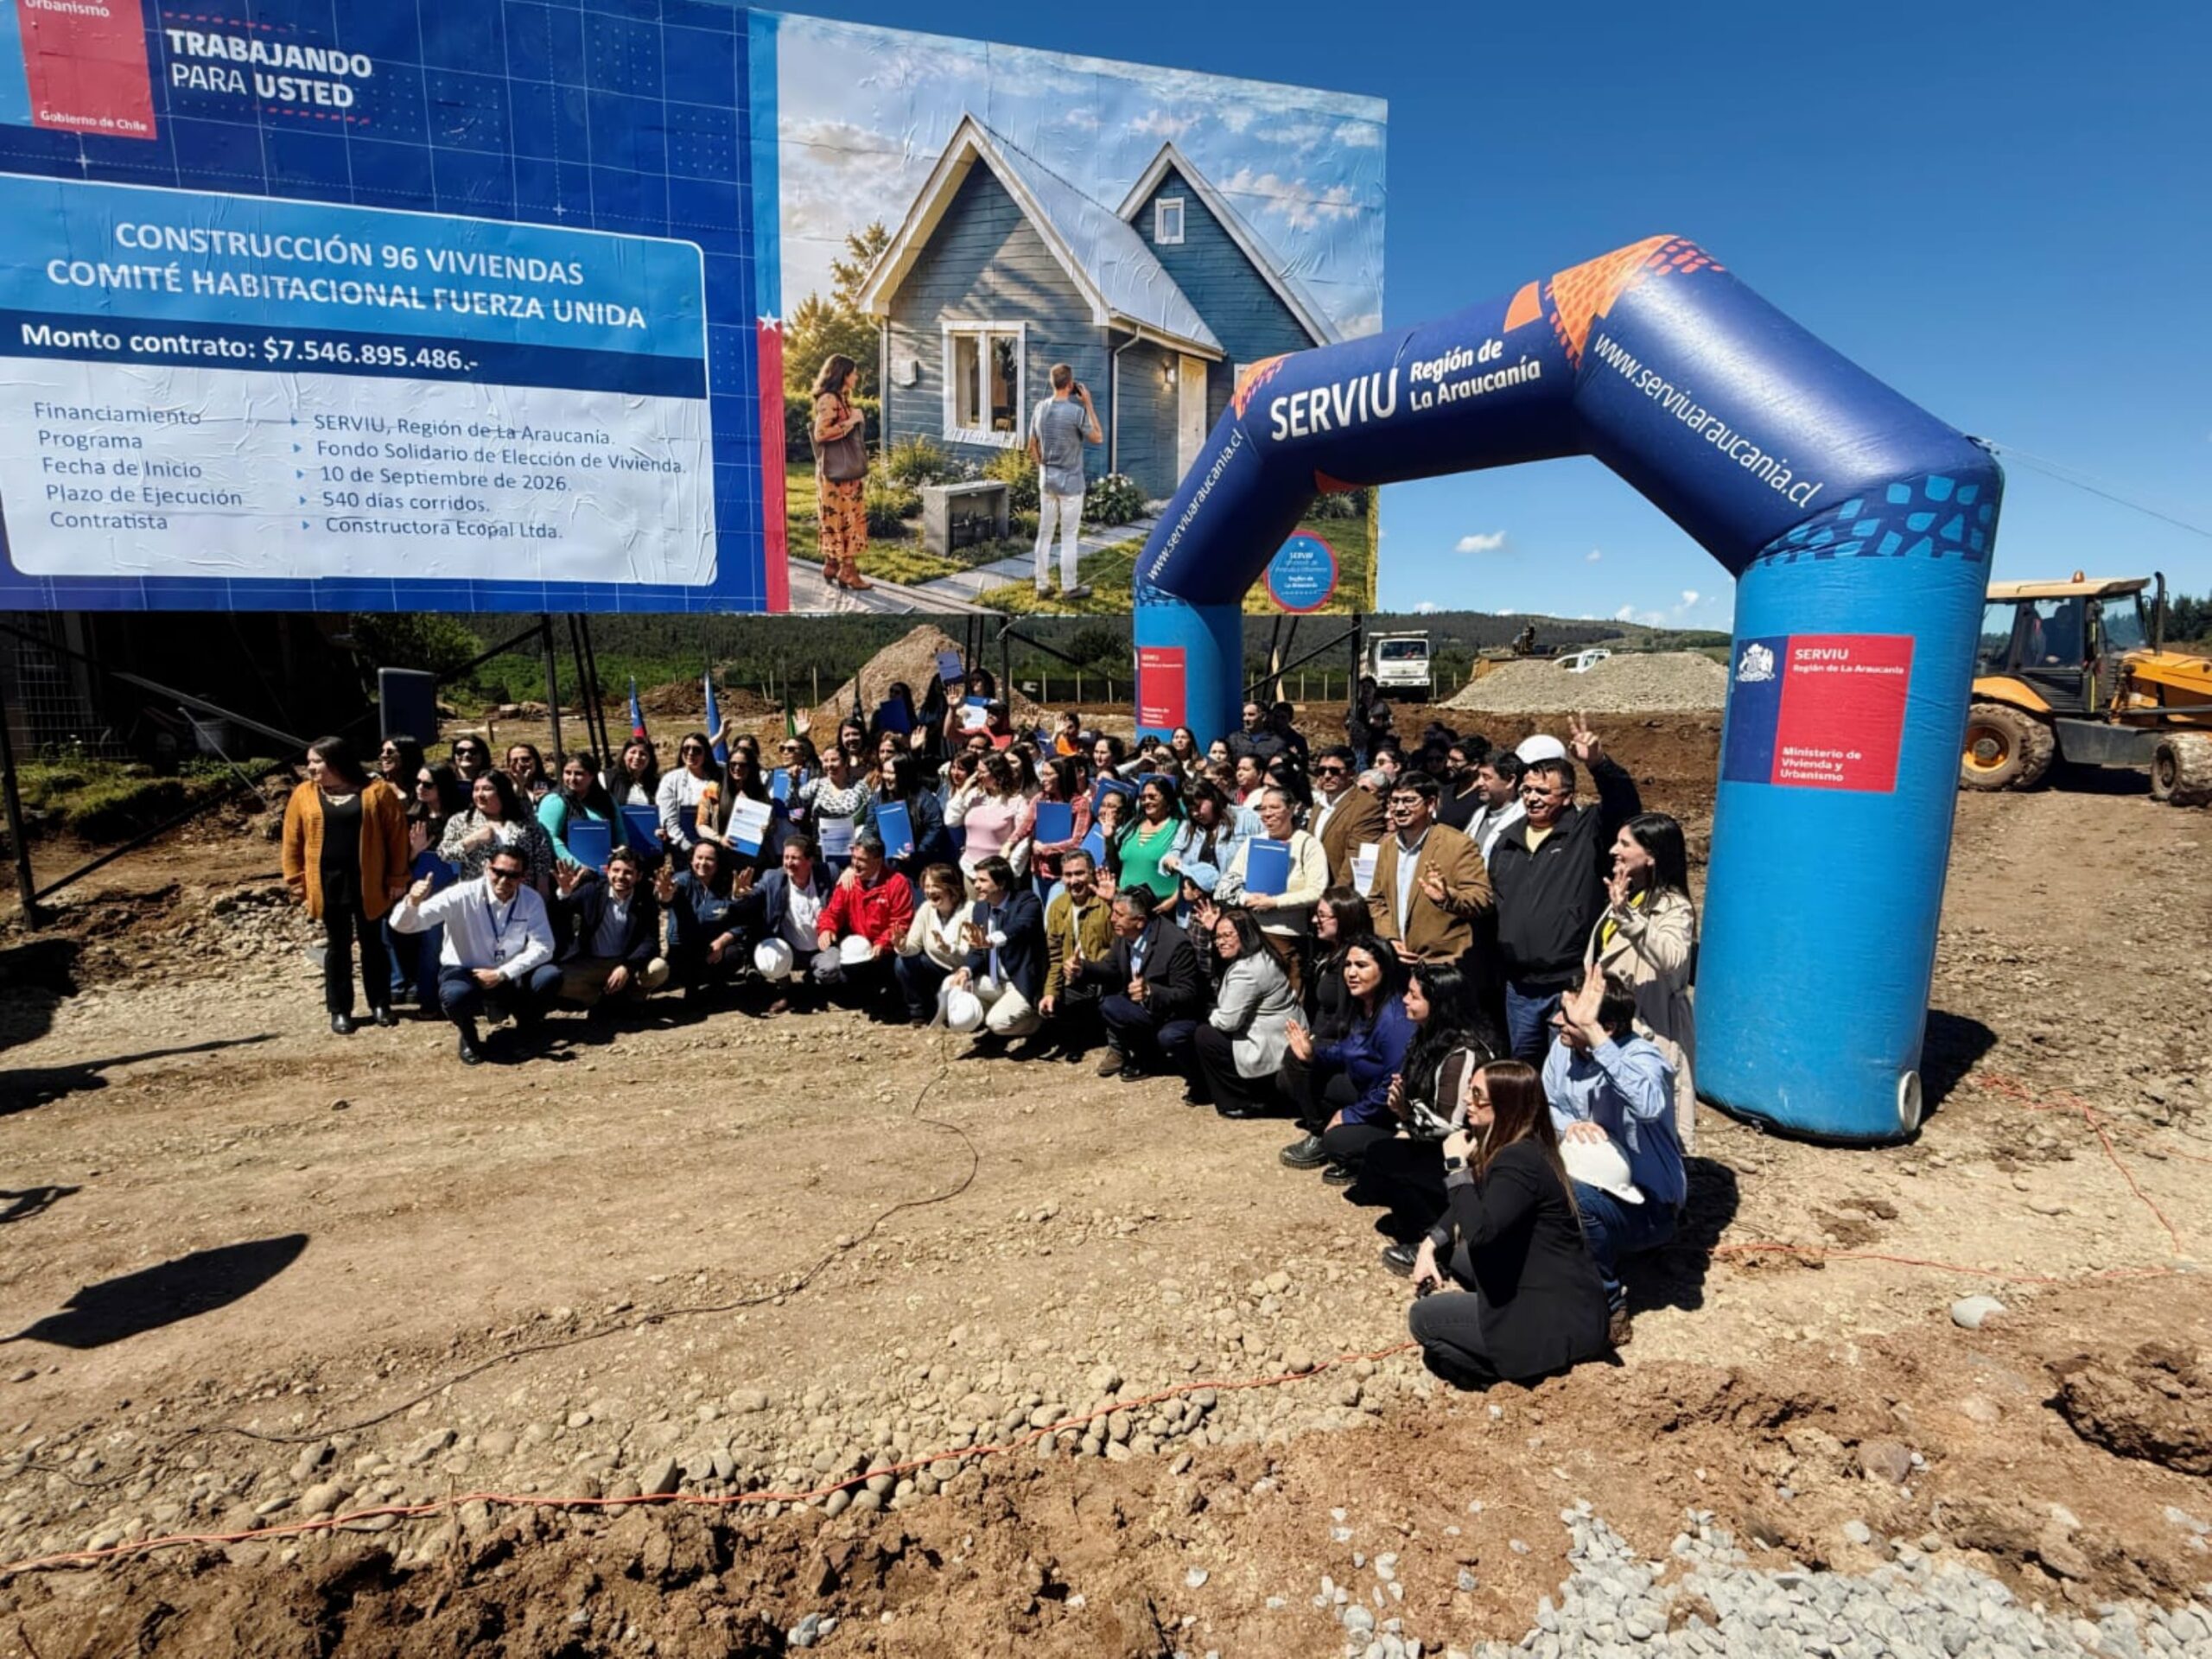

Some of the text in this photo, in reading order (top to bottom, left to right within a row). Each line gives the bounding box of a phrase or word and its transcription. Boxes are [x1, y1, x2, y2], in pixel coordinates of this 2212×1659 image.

[165, 29, 372, 79] TRABAJANDO
[171, 62, 354, 108] PARA USTED
[40, 110, 147, 131] Gobierno de Chile
[116, 222, 584, 285] CONSTRUCCIÓN 96 VIVIENDAS
[47, 258, 646, 329] COMITÉ HABITACIONAL FUERZA UNIDA
[22, 323, 479, 372] Monto contrato: $7.546.895.486.-
[1410, 338, 1503, 383] Región de
[1410, 355, 1541, 411] La Araucanía
[35, 402, 201, 426] Financiamiento
[1270, 367, 1400, 442] SERVIU
[314, 414, 391, 435] SERVIU,
[397, 417, 461, 438] Región
[467, 423, 492, 437] de
[498, 424, 515, 440] La
[1593, 333, 1824, 508] www.serviuaraucania.cl
[39, 429, 143, 451] Programa
[42, 456, 202, 478] Fecha de Inicio
[317, 440, 687, 474] Fondo Solidario de Elección de Vivienda.
[321, 465, 572, 492] 10 de Septiembre de 2026.
[47, 484, 242, 507] Plazo de Ejecución
[322, 490, 491, 512] 540 días corridos.
[1147, 427, 1244, 581] www.serviuaraucania.cl
[50, 511, 168, 531] Contratista
[326, 517, 563, 540] Constructora Ecopal Ltda.
[1795, 648, 1849, 661] SERVIU
[1827, 664, 1839, 673] de
[1840, 664, 1853, 673] La
[1782, 758, 1843, 772] Vivienda y
[1783, 746, 1861, 760] Ministerio de
[1780, 769, 1844, 782] Urbanismo
